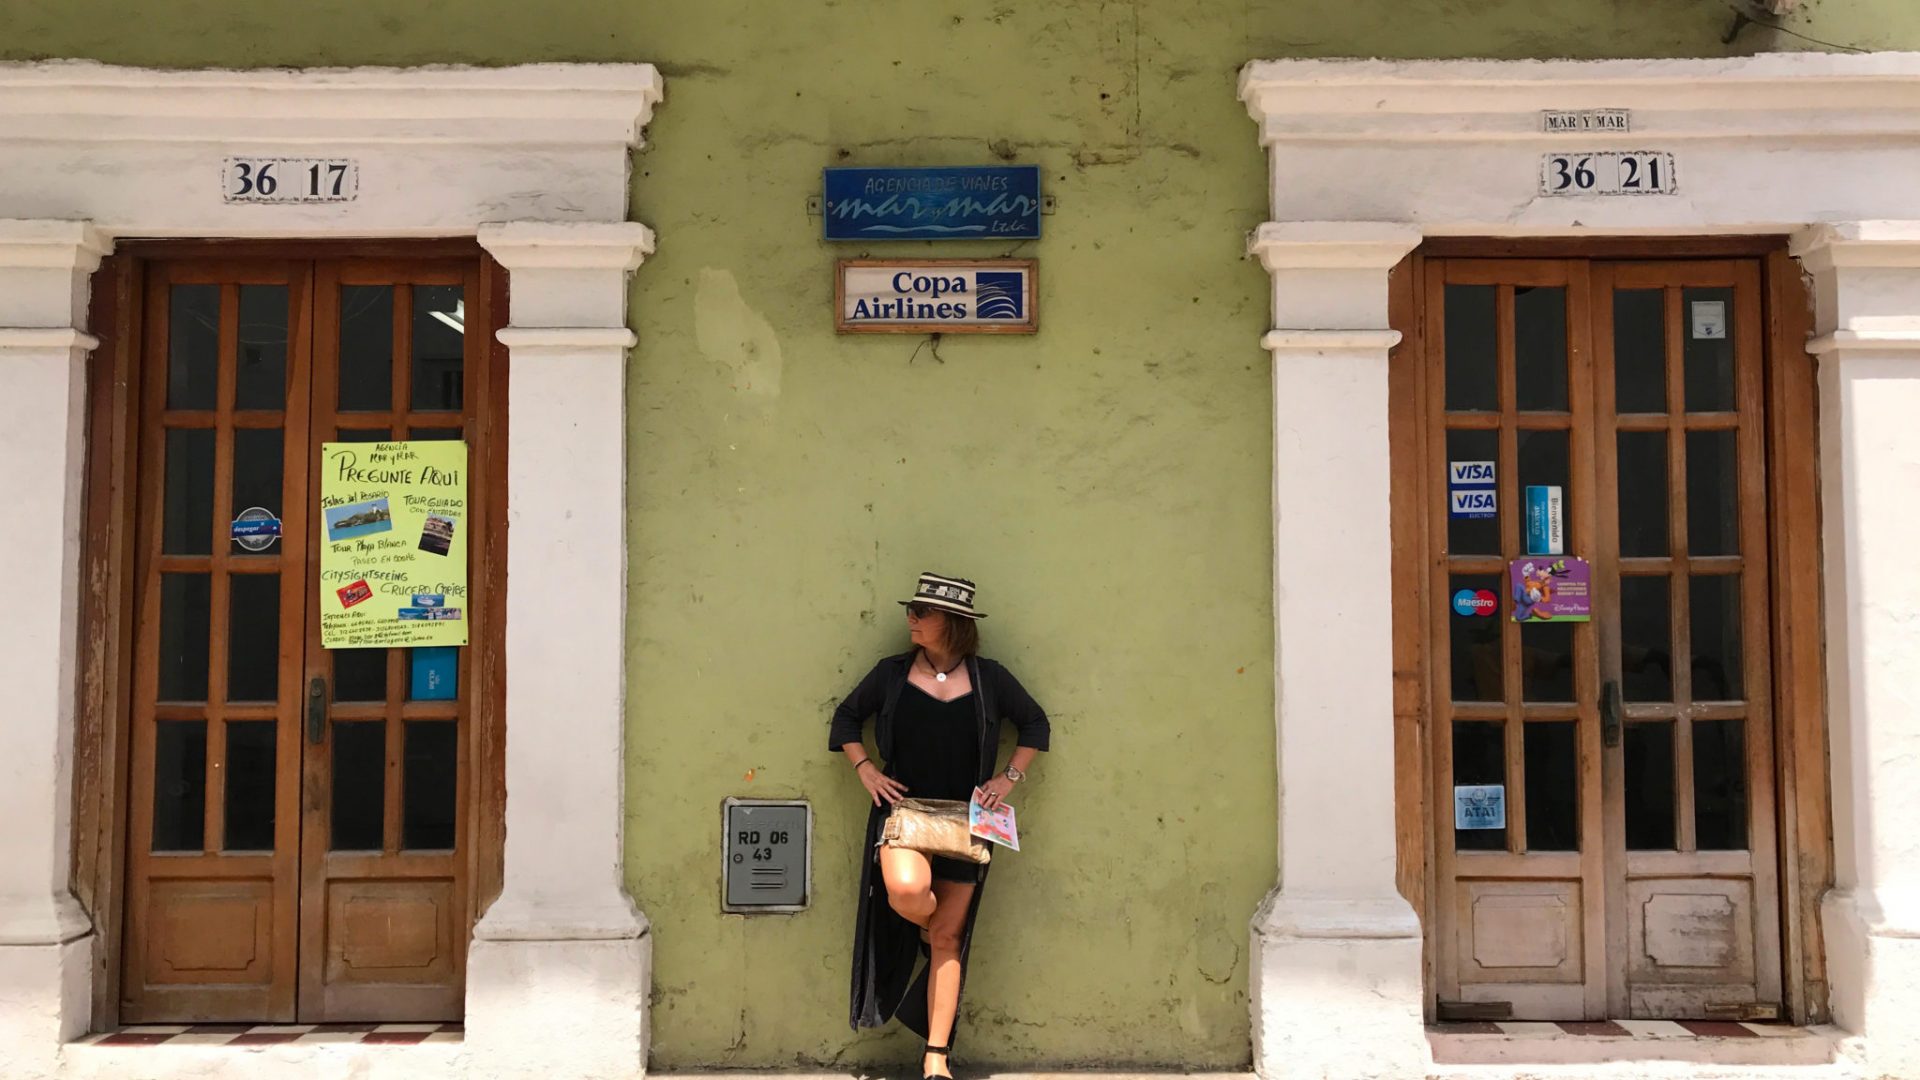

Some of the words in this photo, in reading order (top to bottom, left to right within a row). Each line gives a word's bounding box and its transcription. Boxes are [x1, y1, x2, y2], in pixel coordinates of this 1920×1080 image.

[1548, 116, 1576, 129] MAR
[1583, 116, 1591, 128] Y
[1596, 115, 1625, 128] MAR
[232, 163, 277, 195] 36
[308, 163, 348, 195] 17
[1552, 157, 1595, 190] 36
[1620, 157, 1660, 189] 21
[865, 177, 930, 194] AGENCIA
[934, 176, 957, 193] DE
[961, 175, 1008, 191] VIAJES
[831, 194, 925, 219] mar
[944, 192, 1038, 217] mar
[892, 272, 968, 298] Copa
[852, 298, 967, 319] Airlines
[331, 451, 412, 484] PREGUNTE
[420, 466, 458, 486] AQUI
[1455, 465, 1493, 479] VISA
[403, 494, 427, 506] TOUR
[427, 497, 463, 508] GUIADO
[1456, 494, 1495, 508] VISA
[1551, 498, 1560, 543] Bienvenido
[331, 542, 352, 553] TOUR
[380, 582, 431, 596] CRUCERO
[1458, 598, 1494, 607] Maestro
[738, 831, 760, 845] RD
[770, 831, 789, 844] 06
[752, 847, 772, 861] 43
